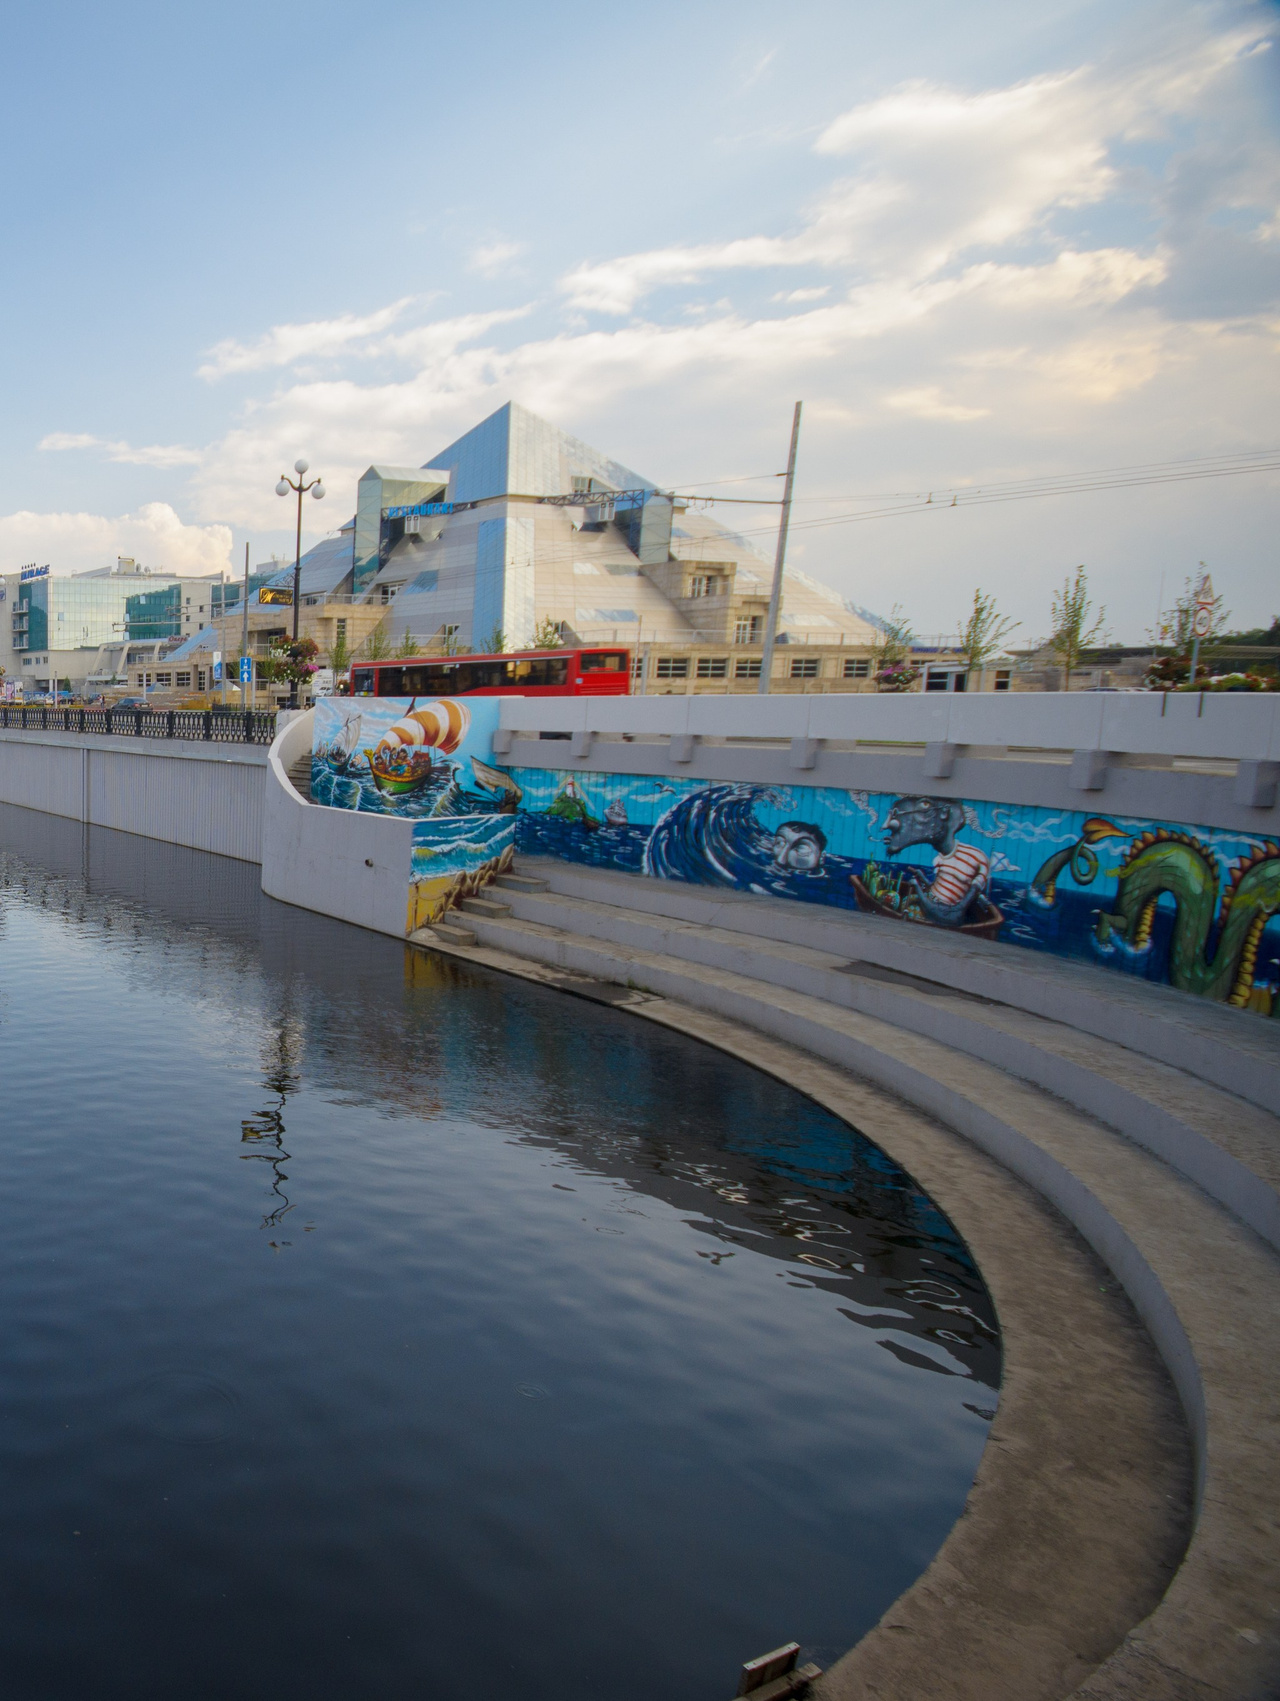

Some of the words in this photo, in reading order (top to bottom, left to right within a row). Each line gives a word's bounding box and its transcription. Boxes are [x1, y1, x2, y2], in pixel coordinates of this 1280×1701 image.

[388, 502, 453, 518] RESTAURANT
[21, 564, 50, 581] MIRAGE
[1197, 615, 1208, 628] 40
